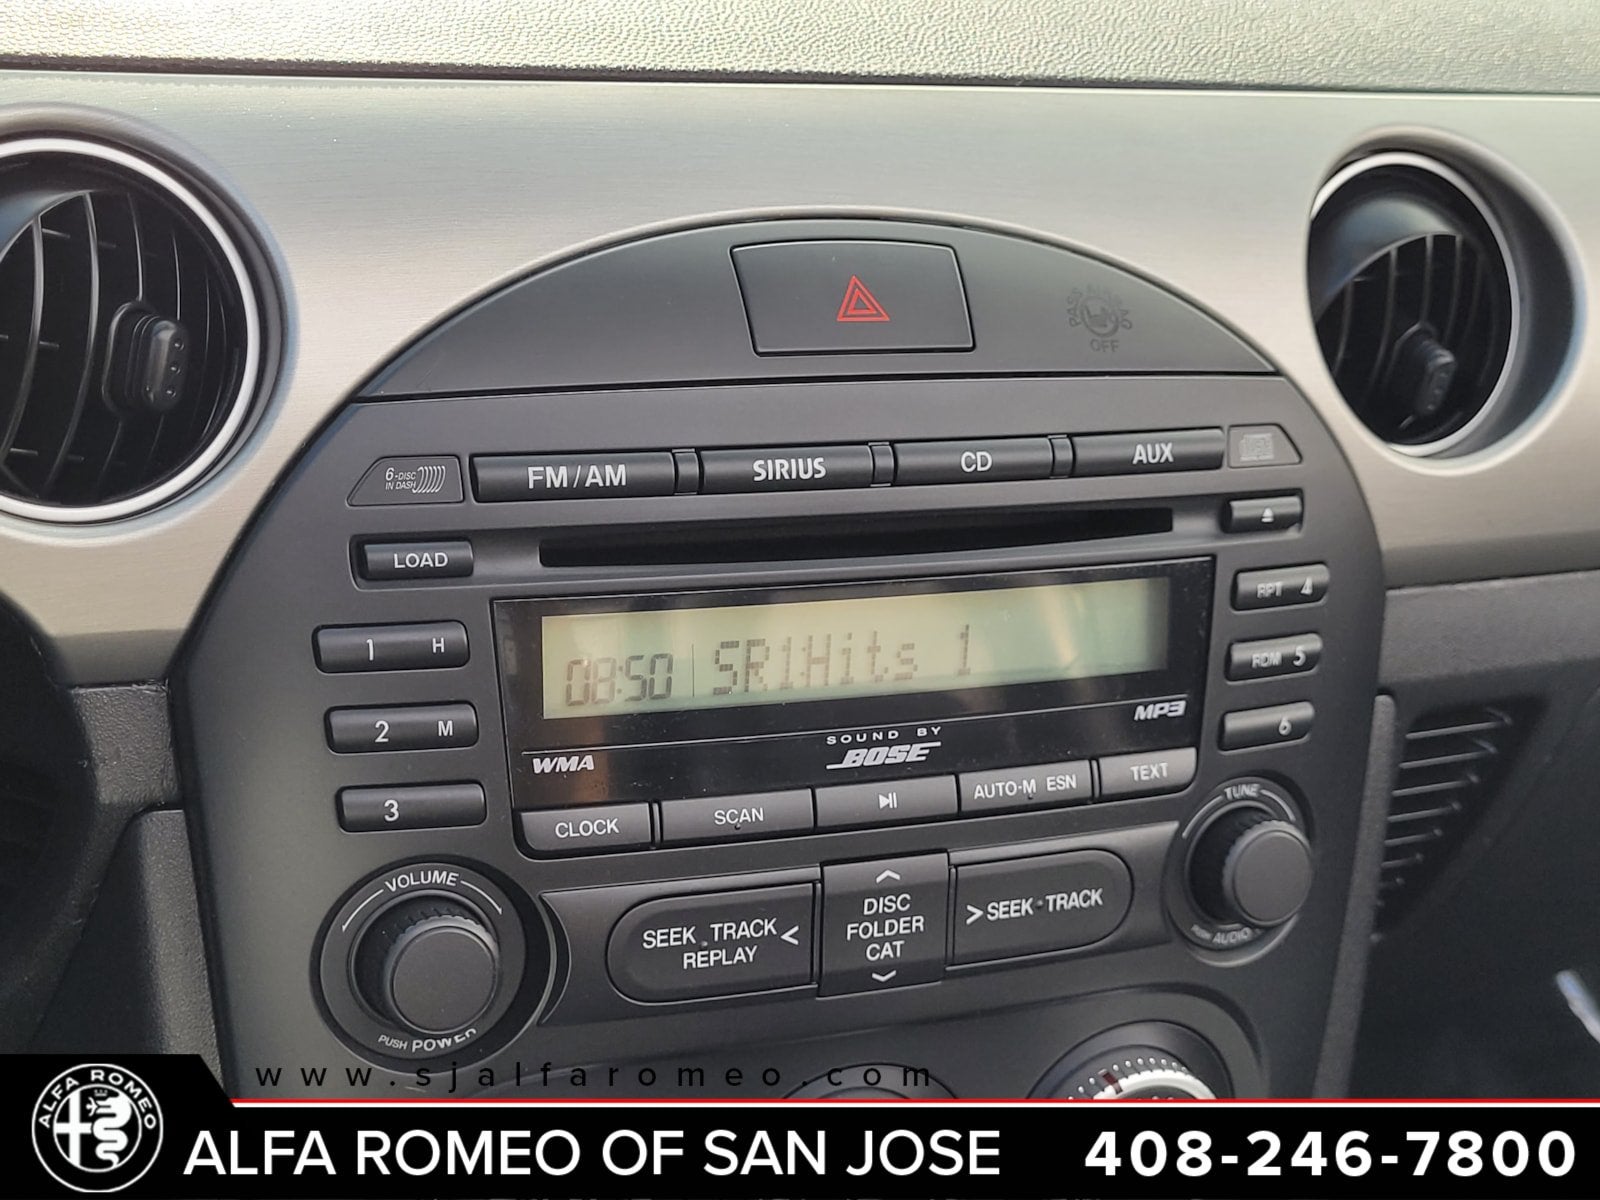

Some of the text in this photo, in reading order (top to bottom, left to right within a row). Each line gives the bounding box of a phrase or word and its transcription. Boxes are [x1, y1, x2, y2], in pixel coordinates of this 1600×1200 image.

[960, 452, 993, 473] CD
[1132, 442, 1174, 464] AUX
[752, 457, 826, 482] SIRIUS
[385, 481, 416, 490] IN DASH
[393, 551, 449, 569] LOAD
[1257, 577, 1313, 598] RPT 4
[366, 637, 445, 661] 1 H
[1252, 646, 1306, 669] RDM 5
[566, 653, 674, 706] 08:50
[1134, 701, 1187, 721] MP3
[375, 720, 454, 743] 2 M
[826, 726, 942, 745] SOUND BY
[1278, 717, 1292, 736] 6
[532, 755, 594, 773] WMA
[826, 741, 942, 770] BOSE
[1130, 763, 1170, 782] TEXT
[973, 774, 1077, 800] AUTO-M ESN
[1223, 783, 1260, 801] TUNE
[384, 800, 400, 822] 3
[714, 807, 765, 826] SCAN
[555, 819, 620, 839] CLOCK
[384, 870, 460, 893] VOLUME
[863, 894, 911, 916] DISC
[987, 888, 1104, 920] SEEK TRACK
[643, 918, 777, 950] SEEK TRACK
[846, 916, 925, 941] FOLDER
[682, 946, 758, 970] REPLAY
[865, 941, 905, 963] CAT
[378, 1034, 408, 1050] PUSH
